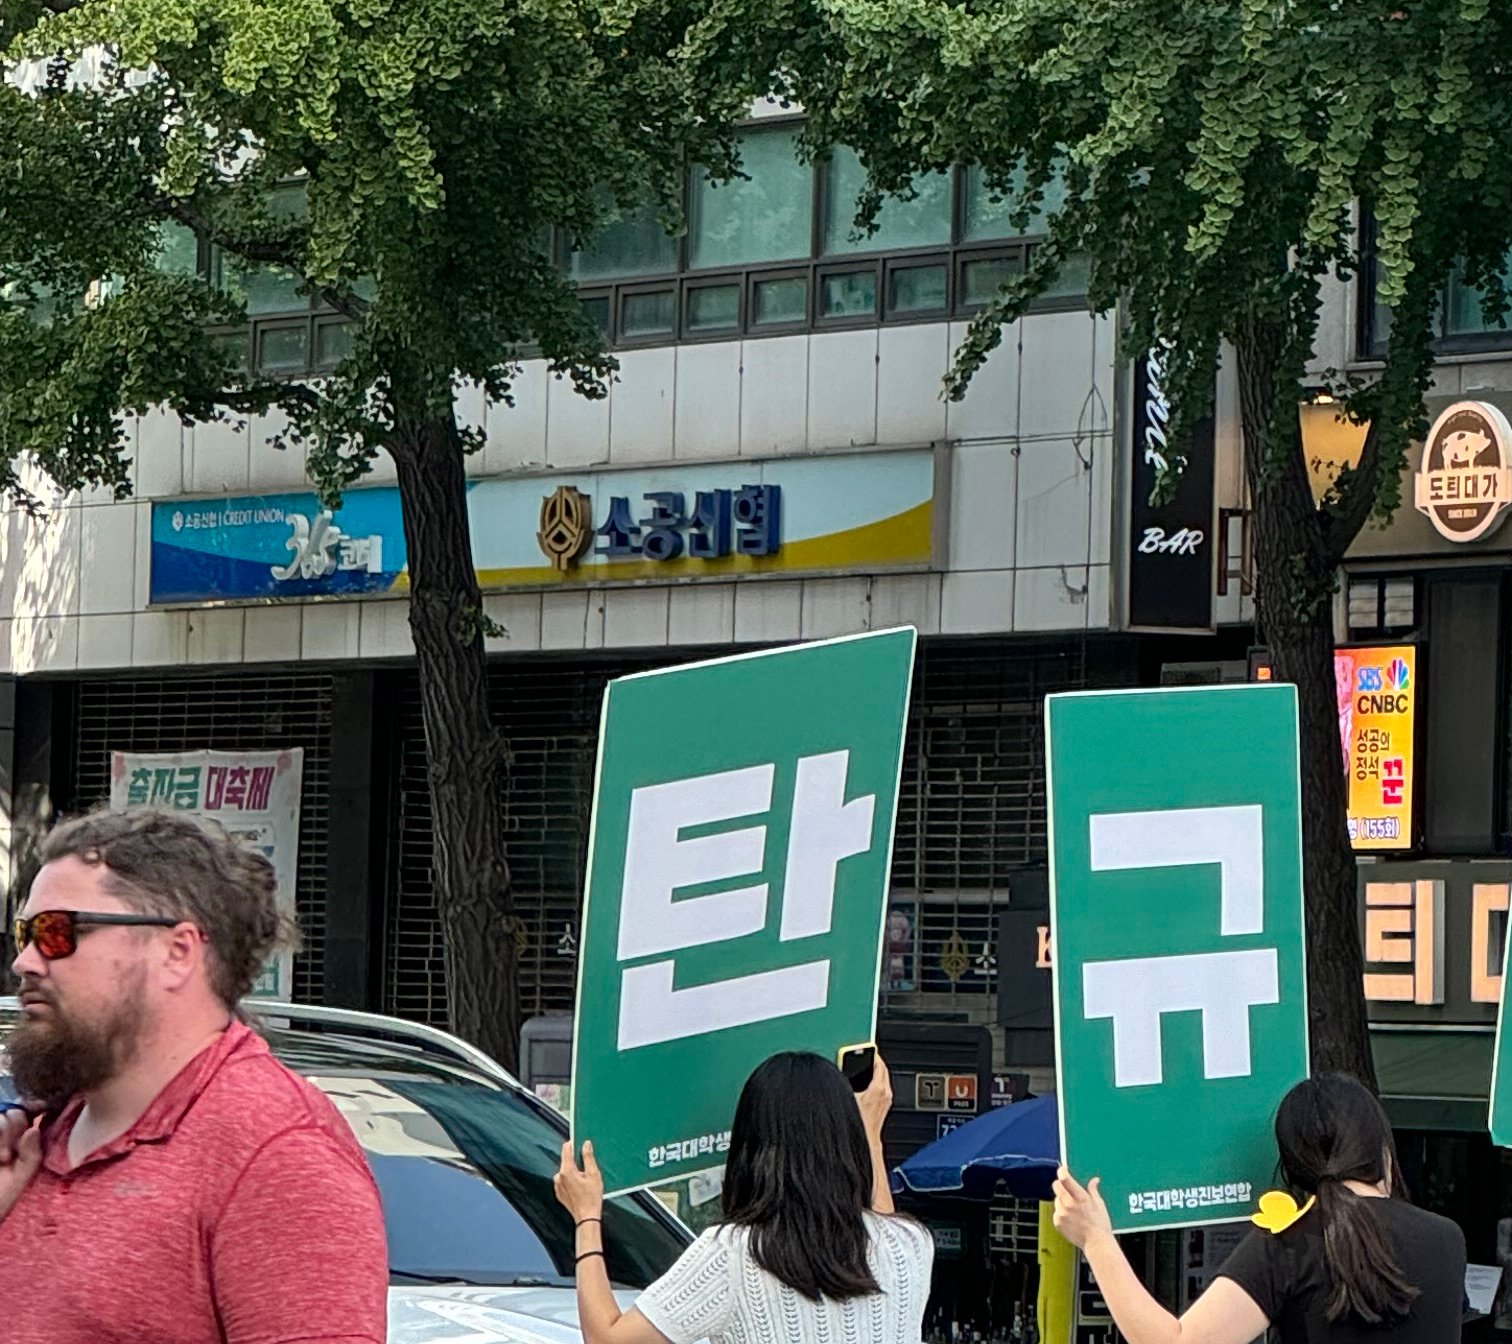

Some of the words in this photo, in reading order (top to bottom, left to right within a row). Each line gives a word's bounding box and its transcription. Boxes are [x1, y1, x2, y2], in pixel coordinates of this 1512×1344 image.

[1430, 473, 1498, 501] 도틔대가
[594, 484, 782, 561] 소공신협
[1137, 527, 1204, 555] BAR
[1357, 667, 1384, 691] SBS
[1357, 694, 1408, 714] CNBC
[1356, 728, 1390, 753] 성공의
[1356, 756, 1379, 781] 정석
[127, 766, 202, 809] 출자금
[205, 766, 276, 811] 대축제
[618, 749, 876, 1051] 탄
[1083, 805, 1280, 1087] 규
[1128, 1182, 1253, 1214] 한국대학생진보연합
